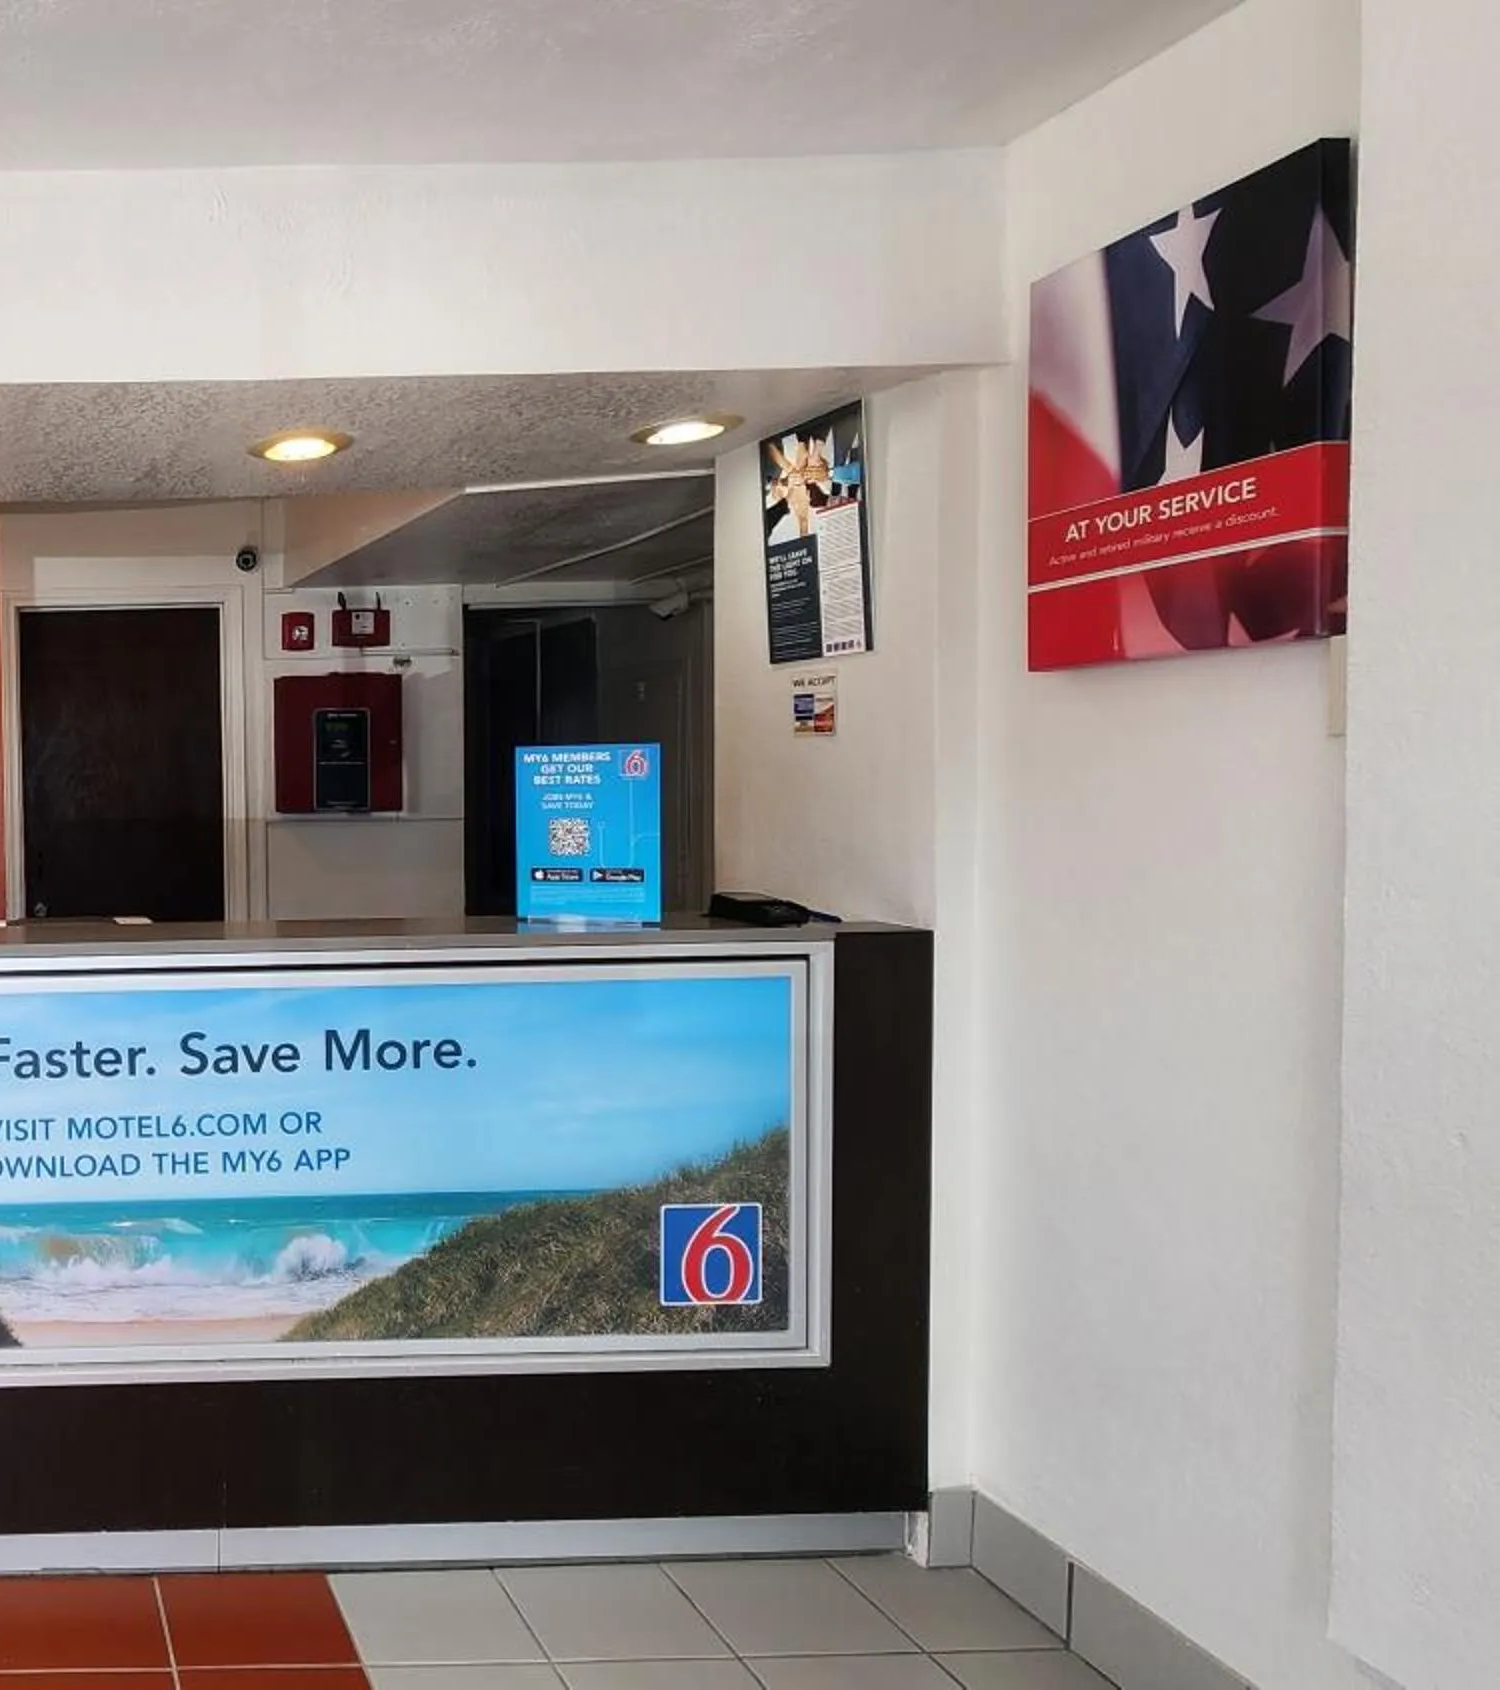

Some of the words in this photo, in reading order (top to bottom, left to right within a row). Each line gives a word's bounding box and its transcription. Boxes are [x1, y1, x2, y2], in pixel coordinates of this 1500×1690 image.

[1065, 519, 1090, 543] AT
[1095, 504, 1152, 535] YOUR
[1158, 476, 1257, 520] SERVICE
[1079, 546, 1098, 559] and
[1099, 540, 1131, 556] retired
[1133, 530, 1171, 547] military
[541, 764, 564, 774] GET
[567, 764, 594, 773] OUR
[551, 752, 611, 762] MEMBERS
[533, 776, 561, 785] BEST
[565, 775, 601, 785] RATES
[179, 1031, 300, 1076] Save
[324, 1029, 477, 1072] More.
[67, 1112, 268, 1140] MOTEL6.COM
[279, 1111, 322, 1135] OR
[152, 1151, 209, 1176] THE
[222, 1150, 281, 1174] MY6
[294, 1148, 350, 1172] APP
[682, 1202, 754, 1305] 6
